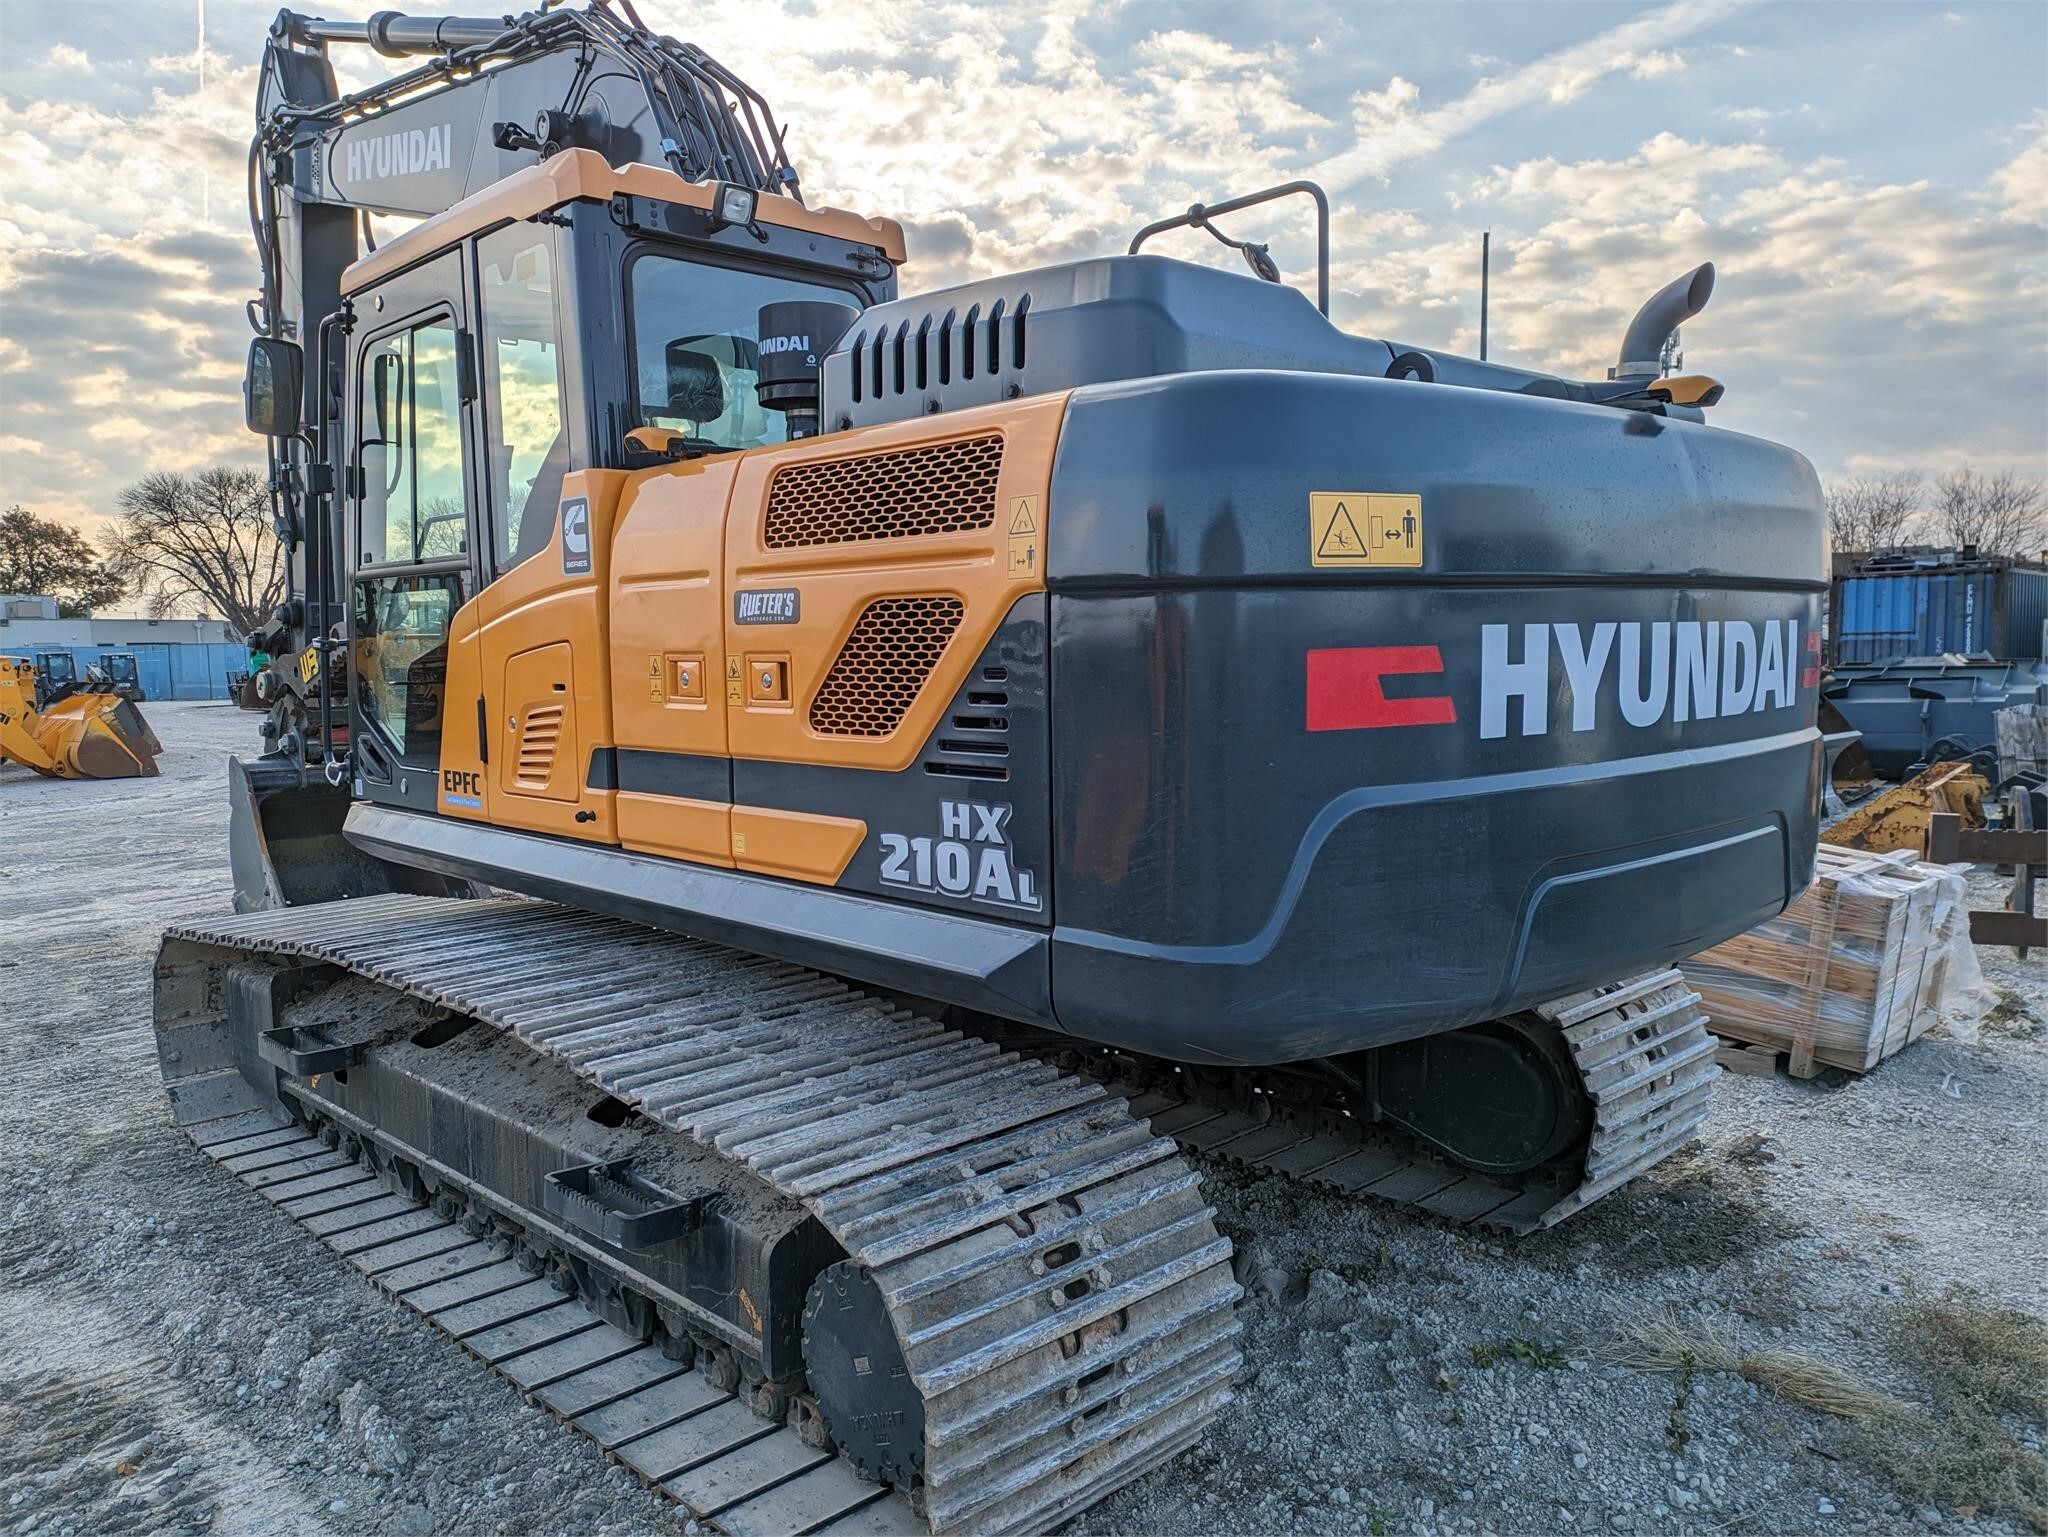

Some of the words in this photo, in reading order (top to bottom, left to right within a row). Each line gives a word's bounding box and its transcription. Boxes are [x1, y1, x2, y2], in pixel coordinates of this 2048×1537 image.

[346, 123, 452, 183] HYUNDAI
[758, 335, 809, 356] UNDAI
[565, 560, 588, 569] SERIES
[739, 592, 795, 618] RUETER'S
[1480, 619, 1799, 739] HYUNDAI
[443, 769, 481, 796] EPFC
[941, 801, 1006, 845] HX
